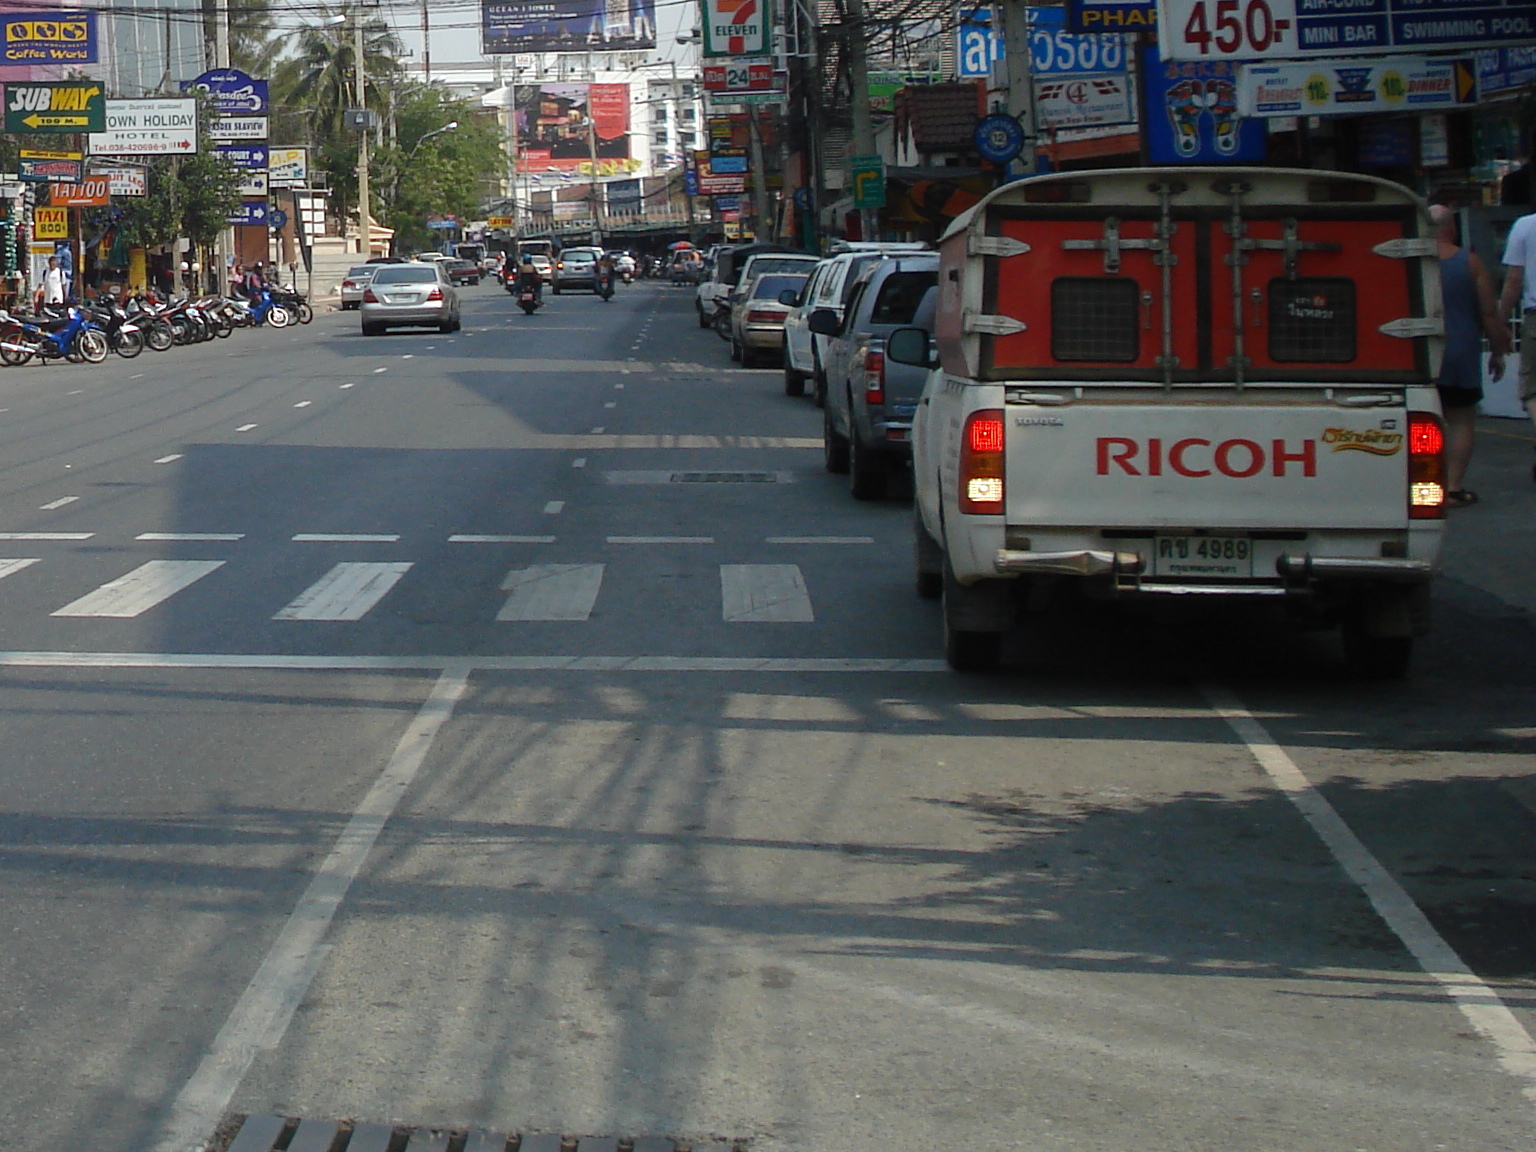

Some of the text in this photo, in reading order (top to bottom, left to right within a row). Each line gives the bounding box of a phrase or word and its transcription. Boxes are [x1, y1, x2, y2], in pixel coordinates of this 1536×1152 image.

[1304, 16, 1534, 45] MINI BAR SWIMMING POOL
[5, 49, 88, 60] Coffee World
[727, 69, 748, 86] 24
[1408, 79, 1451, 93] DINNER
[9, 86, 101, 112] SUBWAY
[144, 114, 194, 127] HOLIDAY
[115, 132, 170, 140] HOTEL
[52, 181, 106, 199] TATTOO
[37, 210, 64, 222] TAXI
[1016, 417, 1064, 427] TOYOTA
[1095, 437, 1317, 478] RICOH
[1197, 539, 1248, 560] 4989
